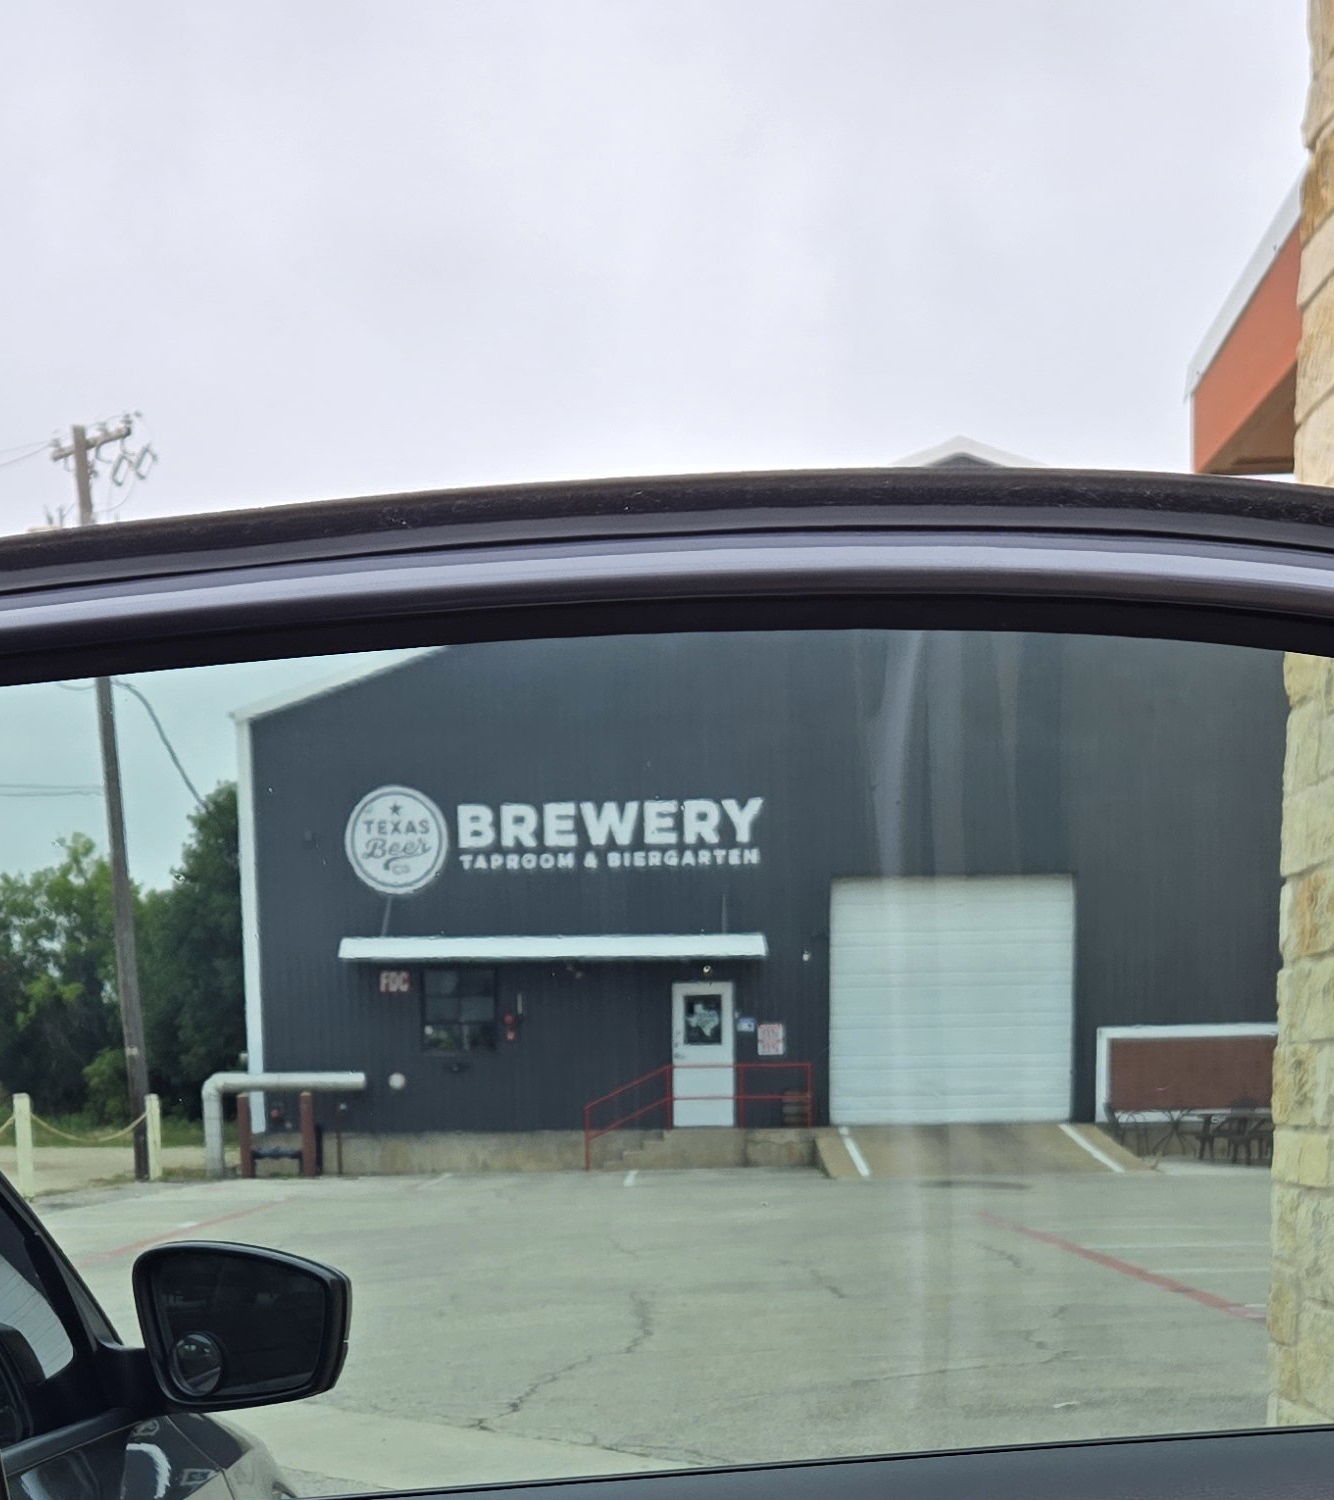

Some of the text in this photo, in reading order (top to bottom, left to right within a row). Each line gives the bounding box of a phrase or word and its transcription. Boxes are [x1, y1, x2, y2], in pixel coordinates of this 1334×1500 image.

[363, 820, 430, 835] TEXAS
[457, 797, 764, 849] BREWERY
[362, 838, 432, 864] Beer
[459, 849, 760, 870] TAPROOM & BIERGARTEN
[380, 971, 410, 992] FDC
